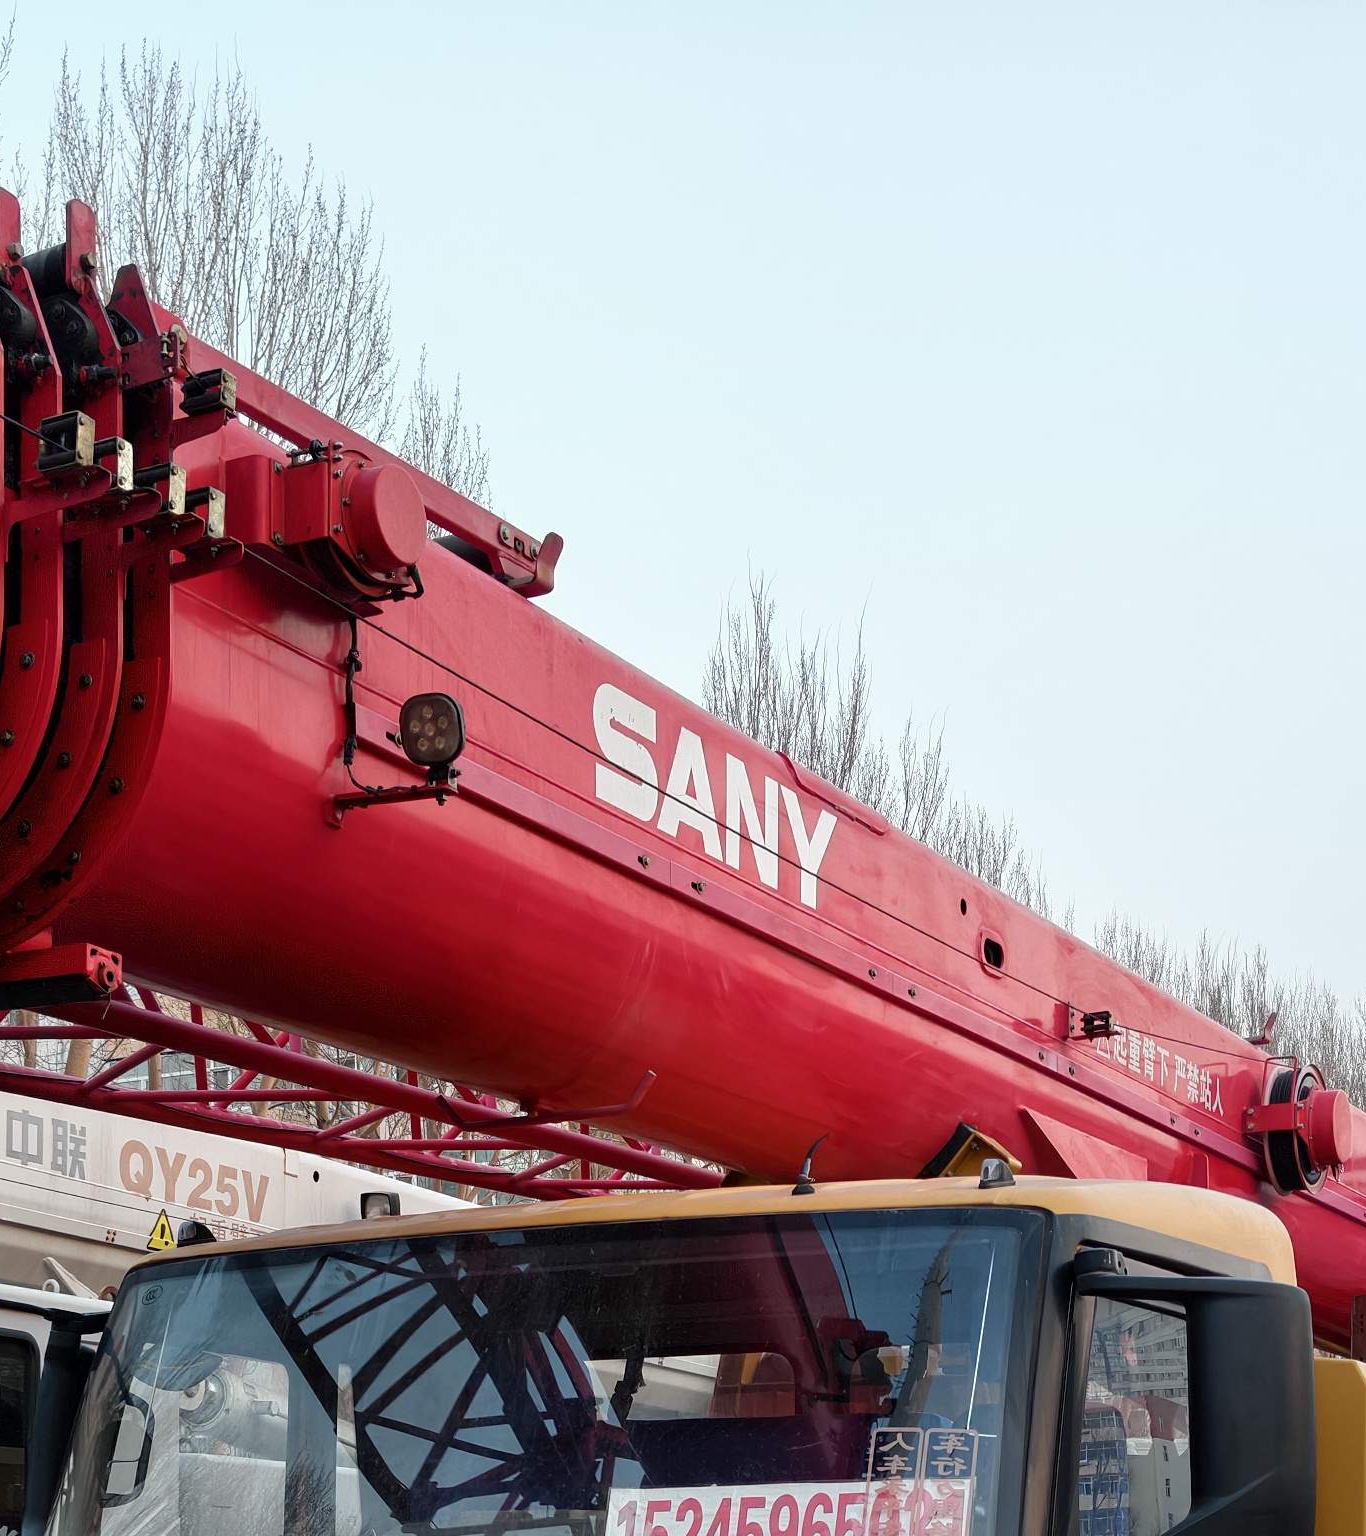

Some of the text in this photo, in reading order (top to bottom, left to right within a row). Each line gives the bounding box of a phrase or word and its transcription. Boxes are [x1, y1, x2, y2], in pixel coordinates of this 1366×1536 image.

[593, 683, 837, 910] SANY
[1173, 1055, 1224, 1117] 严禁站人
[6, 1110, 269, 1222] 中联 QY25V
